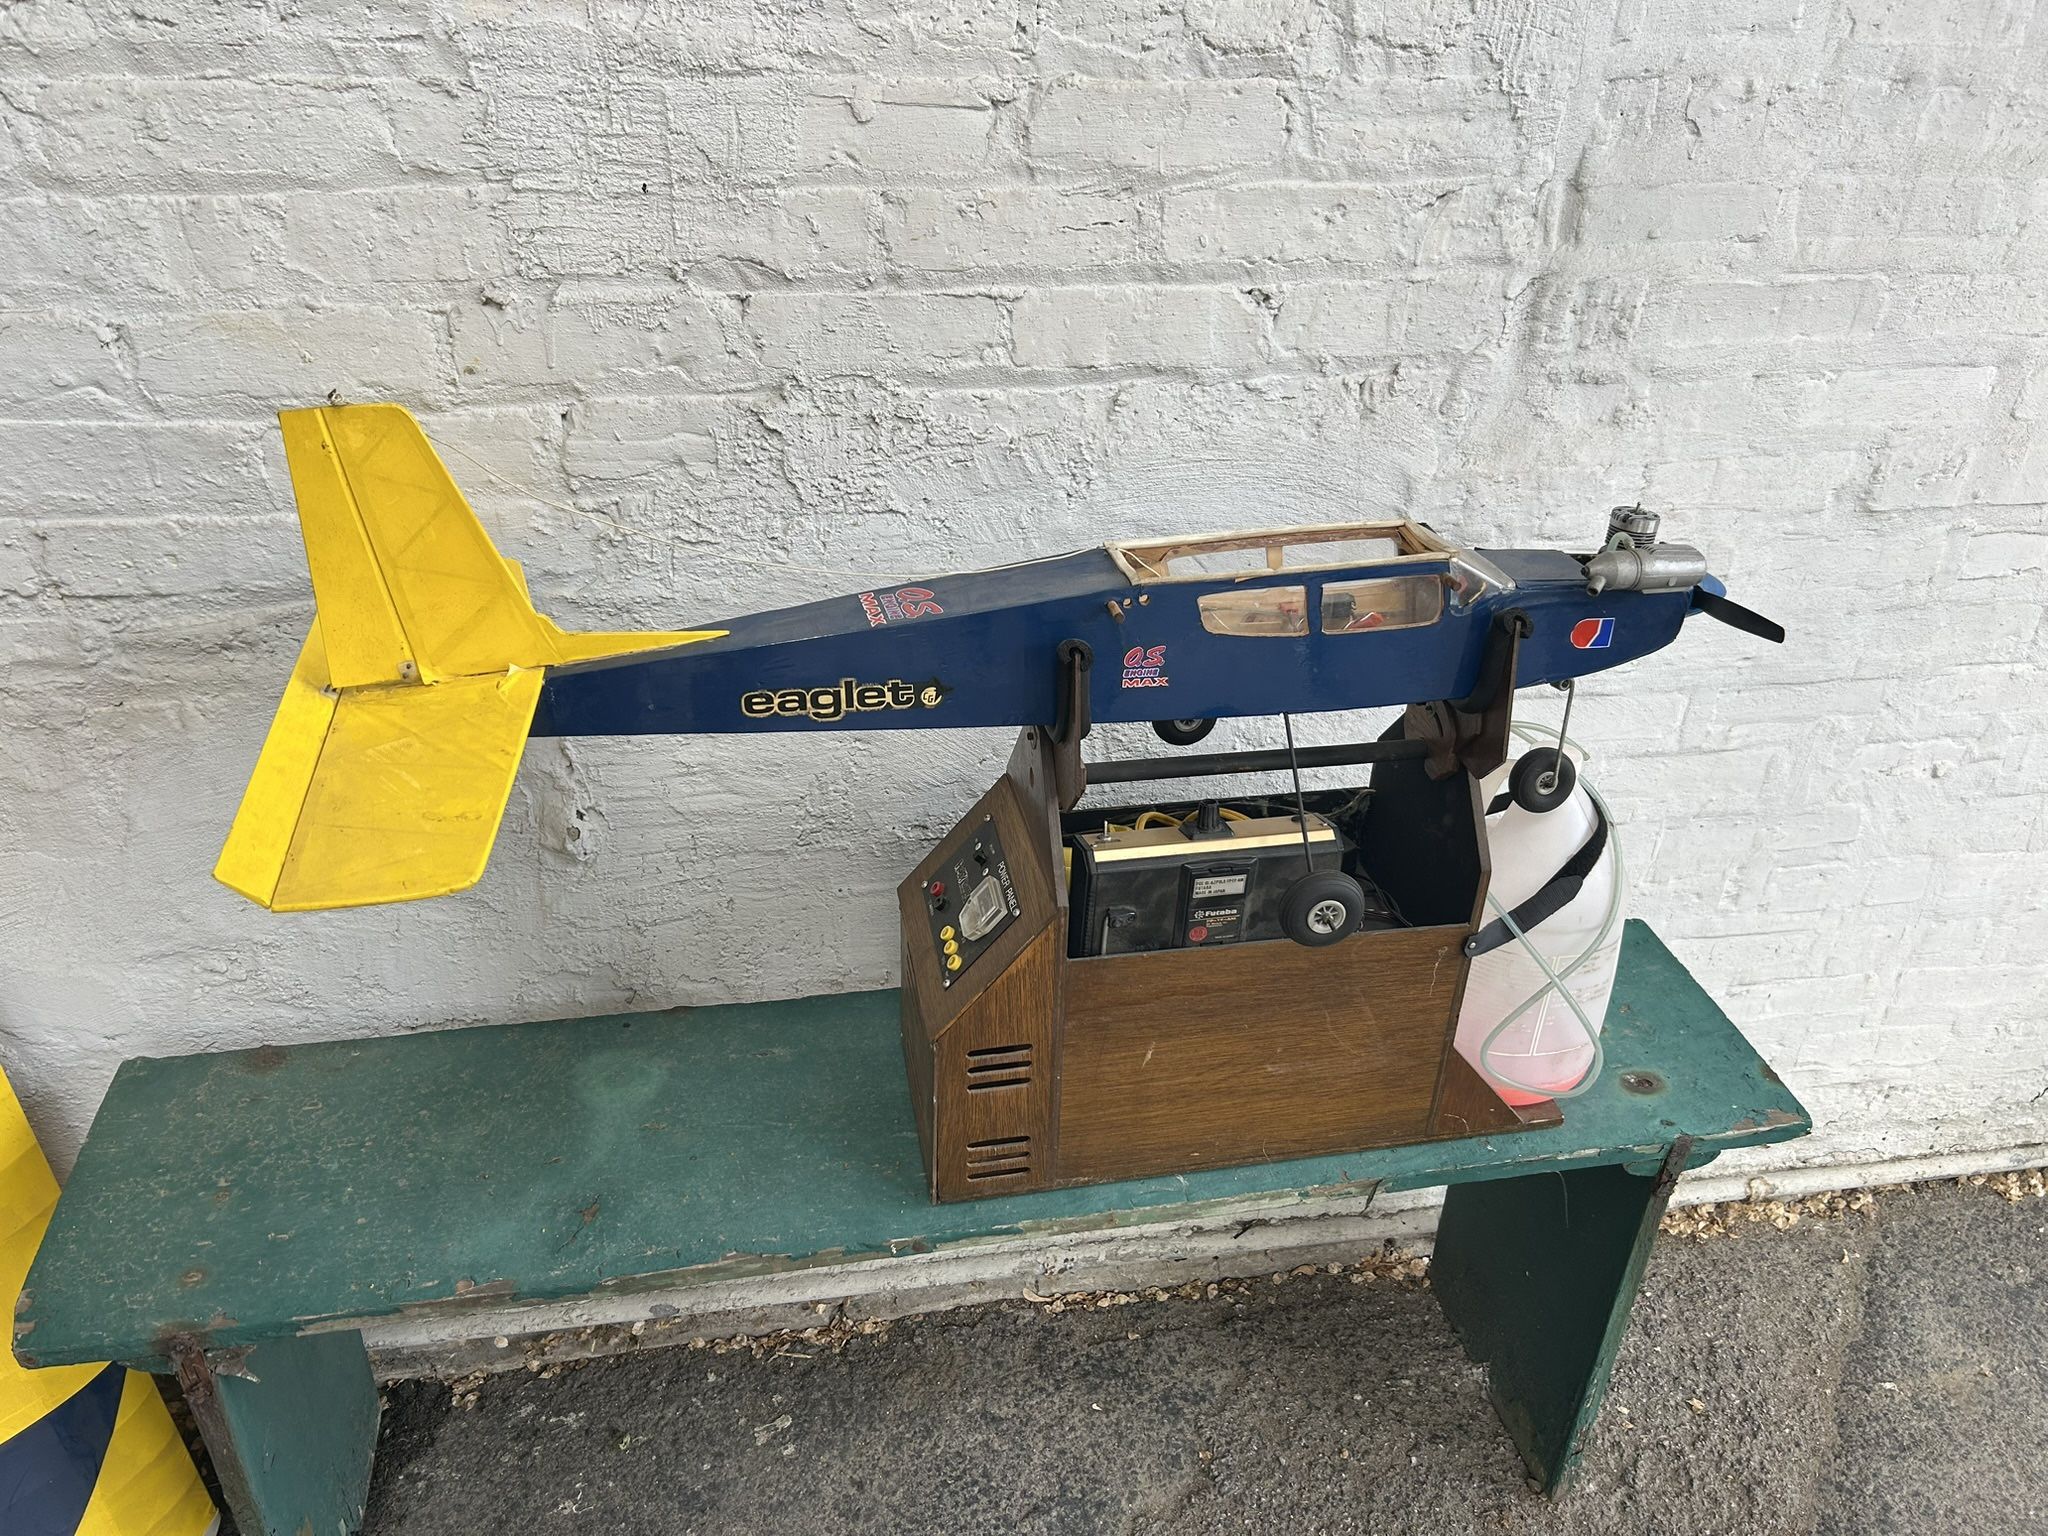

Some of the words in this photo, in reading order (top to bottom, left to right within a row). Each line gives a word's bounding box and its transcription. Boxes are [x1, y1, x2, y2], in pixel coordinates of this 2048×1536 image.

[858, 592, 887, 628] MAX
[880, 593, 904, 620] ENGINE
[1122, 668, 1160, 678] ENGINE
[1122, 677, 1168, 688] MAX
[741, 677, 915, 722] eaglet
[997, 860, 1011, 889] POWER
[1004, 887, 1017, 912] PANEL
[1205, 909, 1237, 917] Futaba
